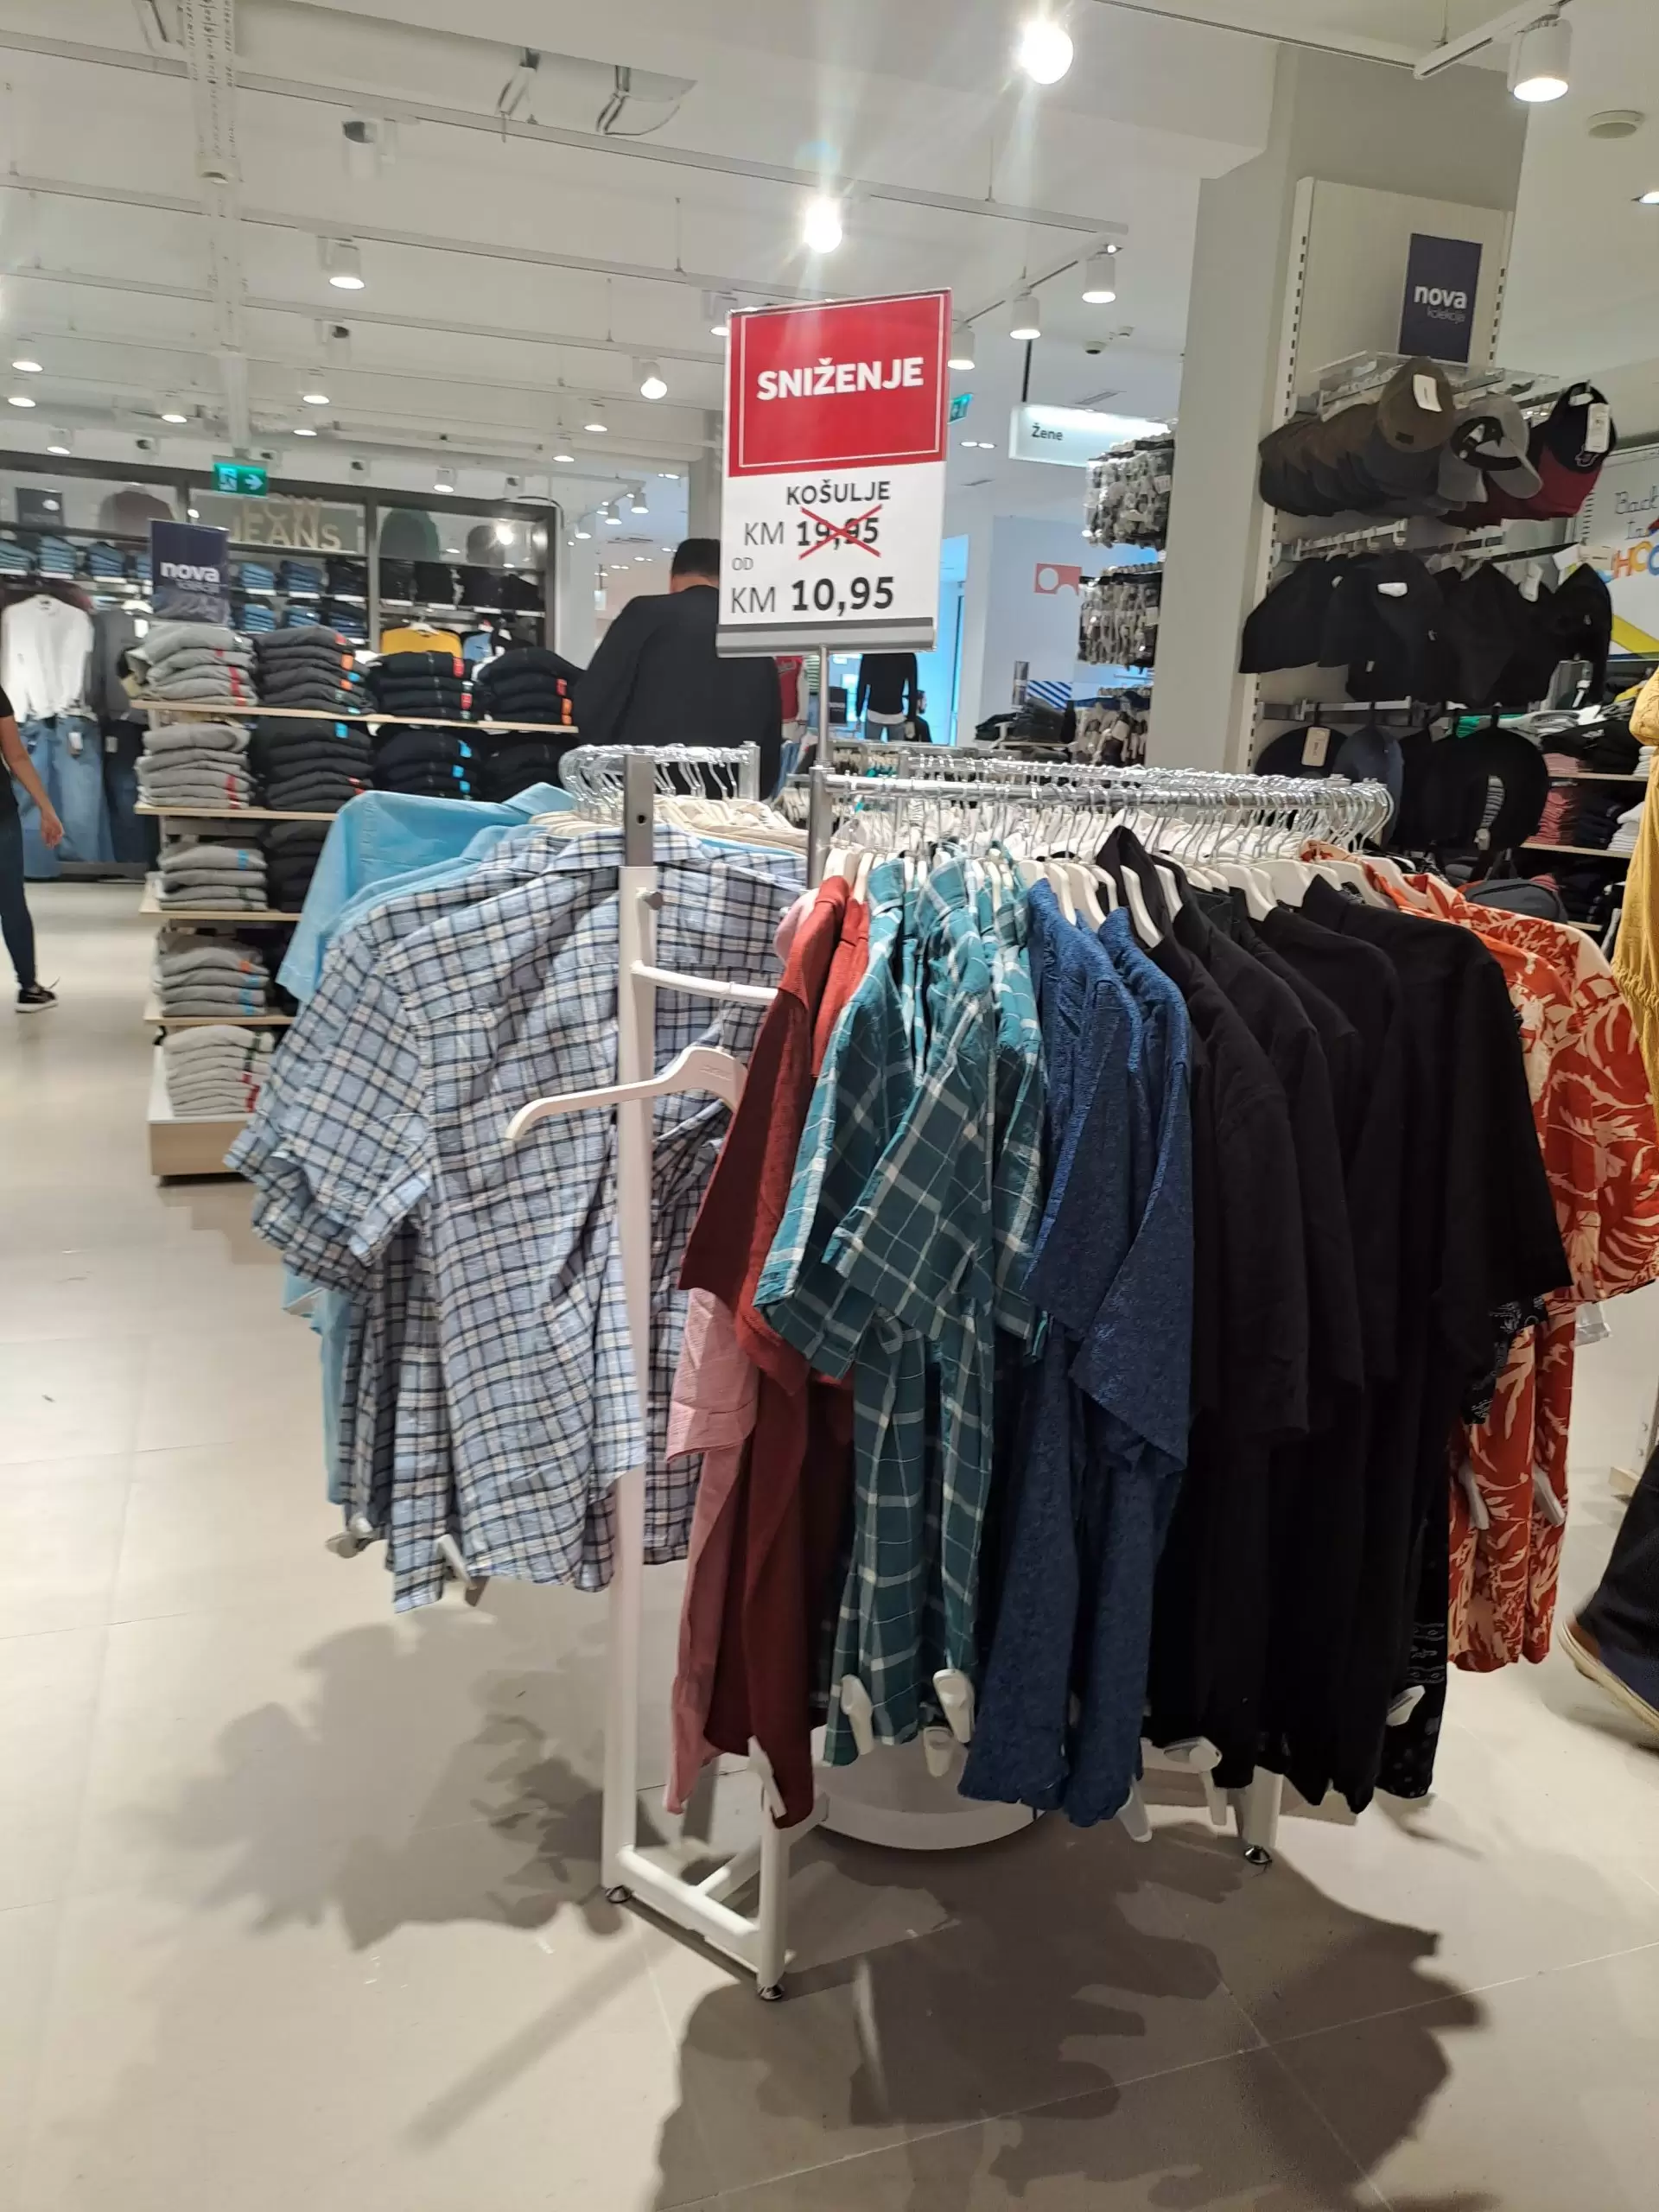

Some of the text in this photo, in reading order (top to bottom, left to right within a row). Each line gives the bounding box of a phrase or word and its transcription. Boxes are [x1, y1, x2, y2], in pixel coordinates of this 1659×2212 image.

[1414, 286, 1467, 309] nova
[757, 357, 925, 401] SNIŽENJE
[1032, 422, 1063, 441] Žene
[786, 480, 891, 505] KOŠULJE
[744, 521, 785, 546] KM
[160, 562, 220, 583] nova
[732, 556, 753, 571] OD
[731, 576, 894, 617] KM 10,95
